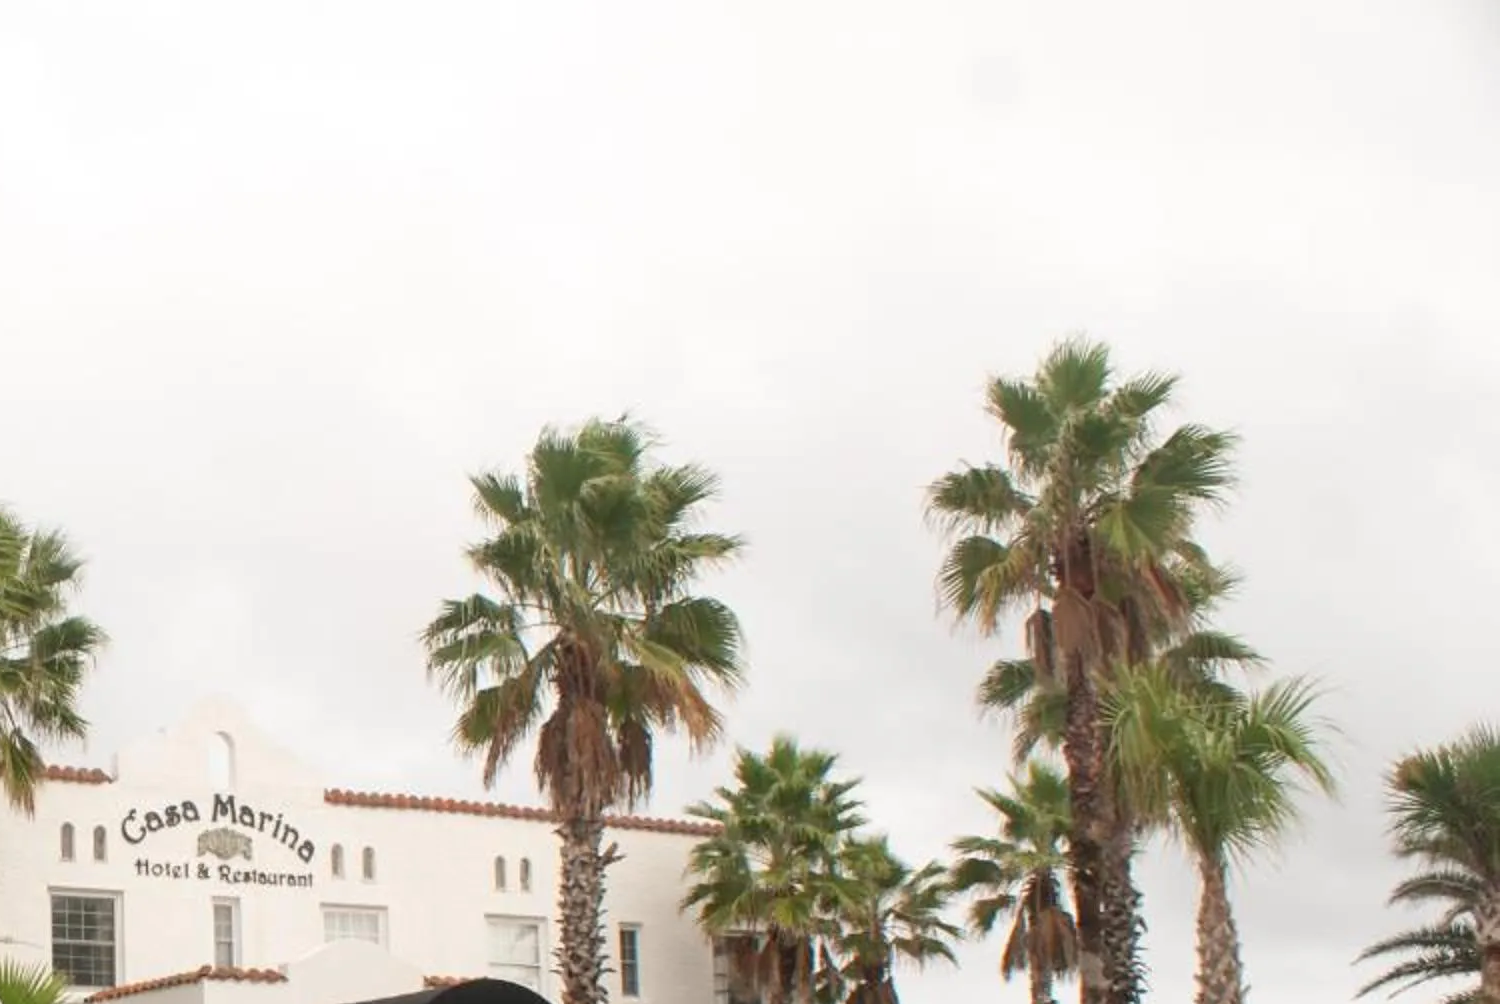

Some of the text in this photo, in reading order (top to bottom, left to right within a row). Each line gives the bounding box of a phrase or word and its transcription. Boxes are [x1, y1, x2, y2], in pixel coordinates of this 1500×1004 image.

[121, 793, 316, 864] Casa Marina
[134, 858, 314, 888] Hotel & Restaurant
